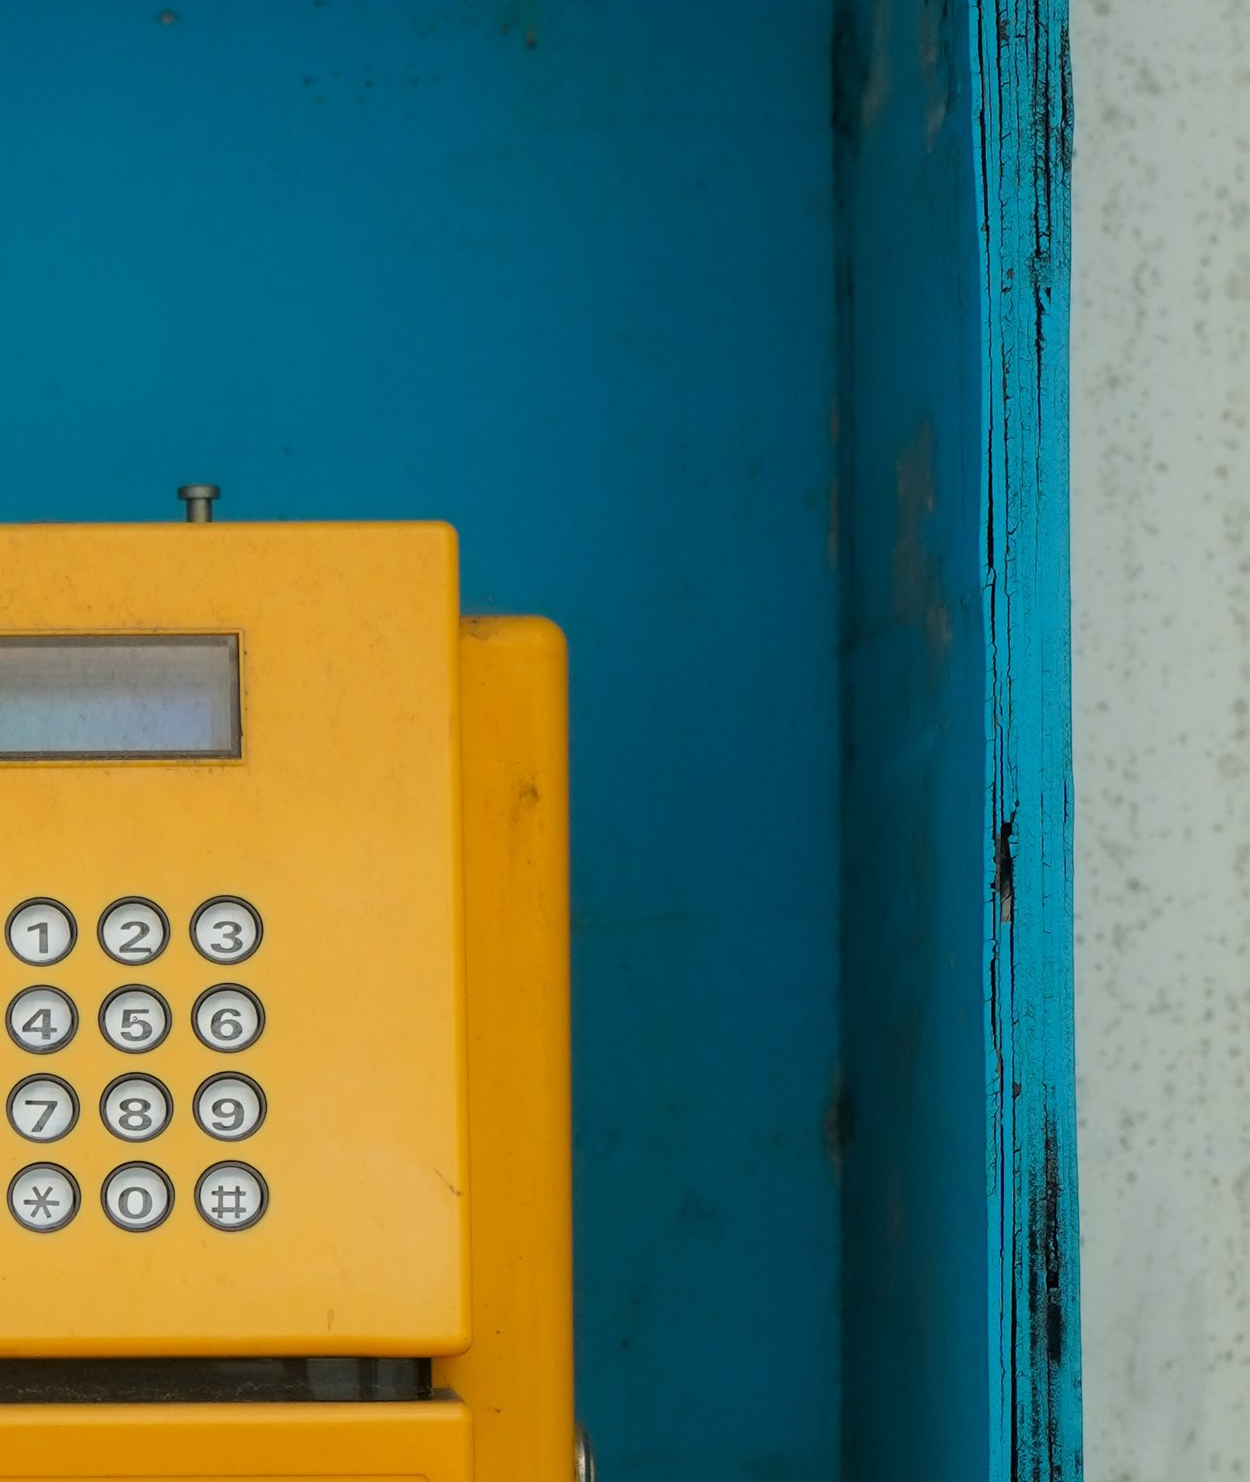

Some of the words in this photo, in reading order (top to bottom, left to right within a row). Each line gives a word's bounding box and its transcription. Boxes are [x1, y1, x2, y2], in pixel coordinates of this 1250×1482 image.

[27, 921, 50, 954] 1
[118, 921, 152, 955] 2
[210, 920, 243, 954] 3
[21, 1008, 58, 1041] 4
[119, 1009, 152, 1042] 5
[209, 1007, 243, 1042] 6
[24, 1099, 59, 1133] 7
[117, 1097, 153, 1132] 8
[211, 1097, 245, 1132] 9
[116, 1186, 153, 1219] 0
